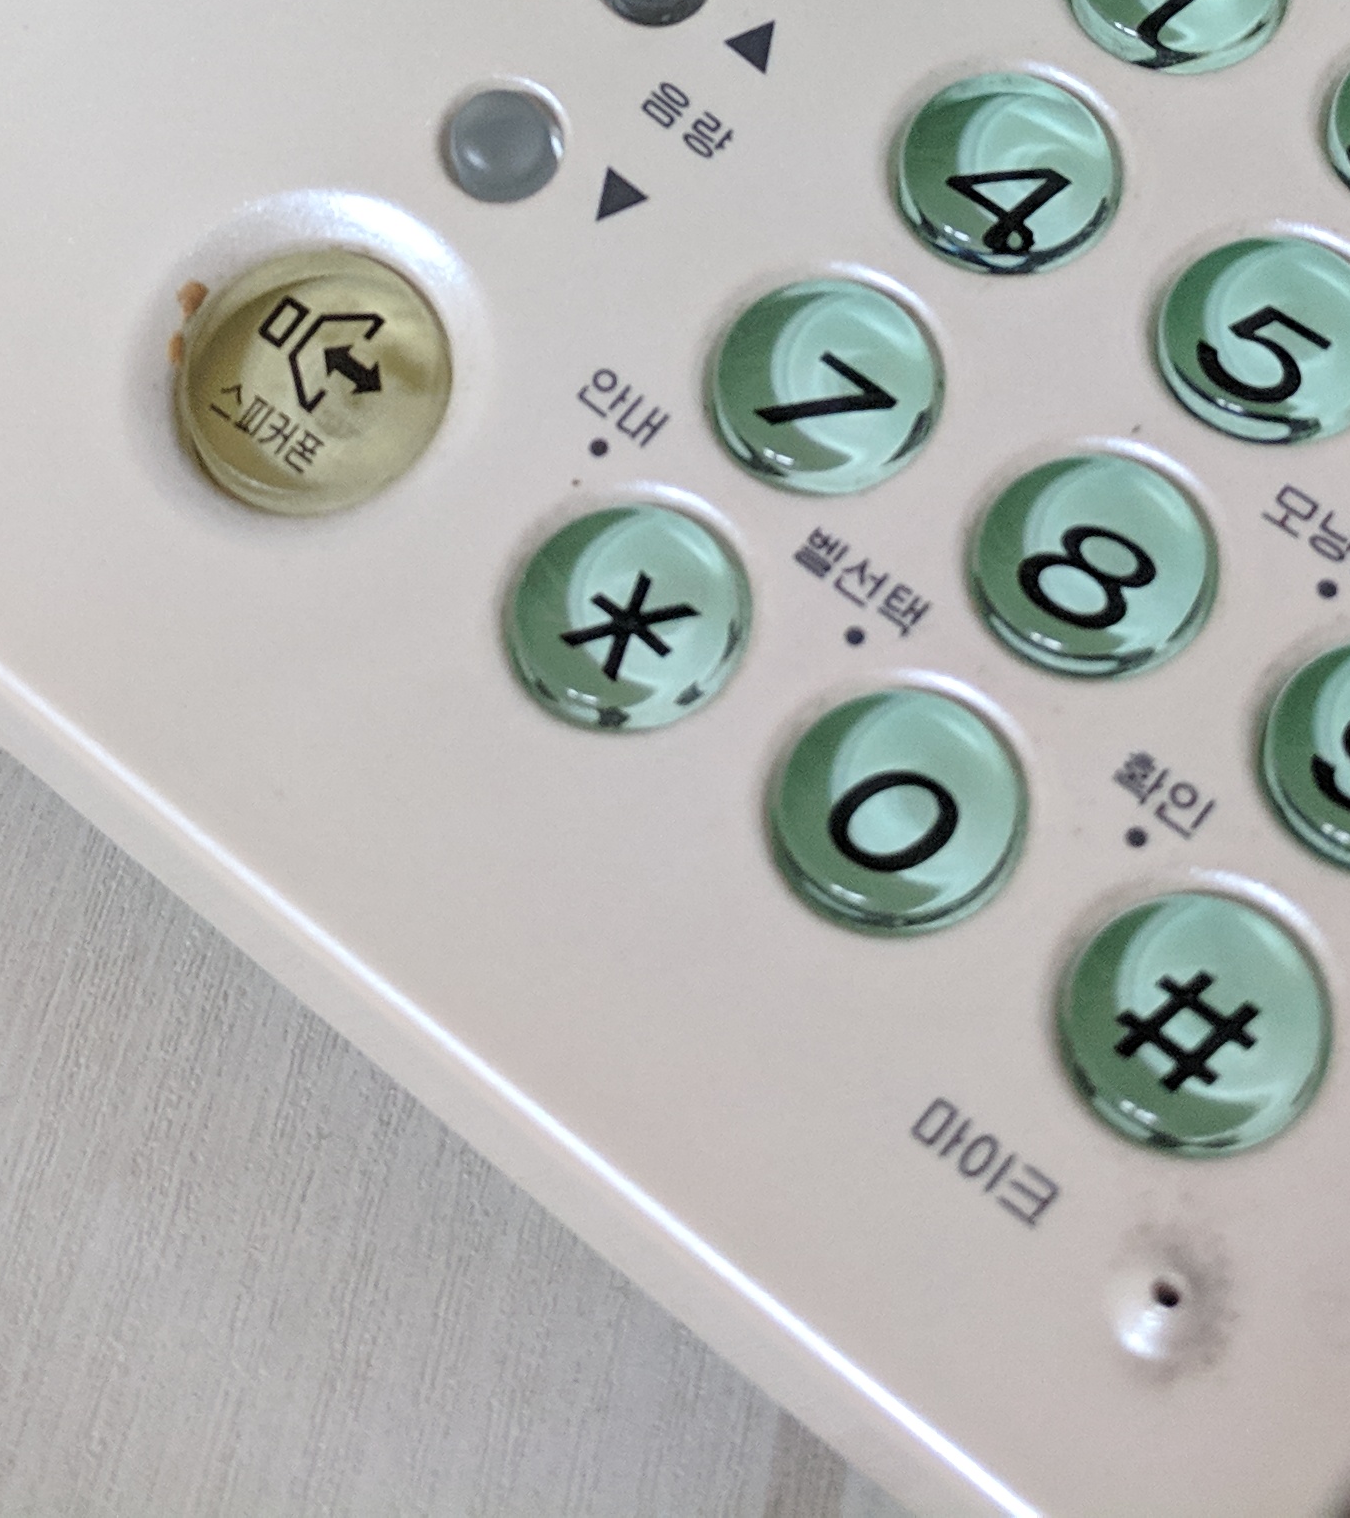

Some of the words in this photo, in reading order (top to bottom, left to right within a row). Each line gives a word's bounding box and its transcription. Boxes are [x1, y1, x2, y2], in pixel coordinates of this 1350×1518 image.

[641, 81, 734, 159] 음량
[945, 167, 1072, 256] 4
[753, 351, 898, 426] 7
[1197, 305, 1332, 405] 5
[207, 383, 326, 474] 스피커폰
[576, 367, 671, 449] 안내
[793, 525, 933, 638] 벨선택
[1017, 524, 1157, 631] 8
[828, 768, 960, 873] 0
[1111, 749, 1216, 840] 확인
[909, 1096, 1062, 1229] 마이크
